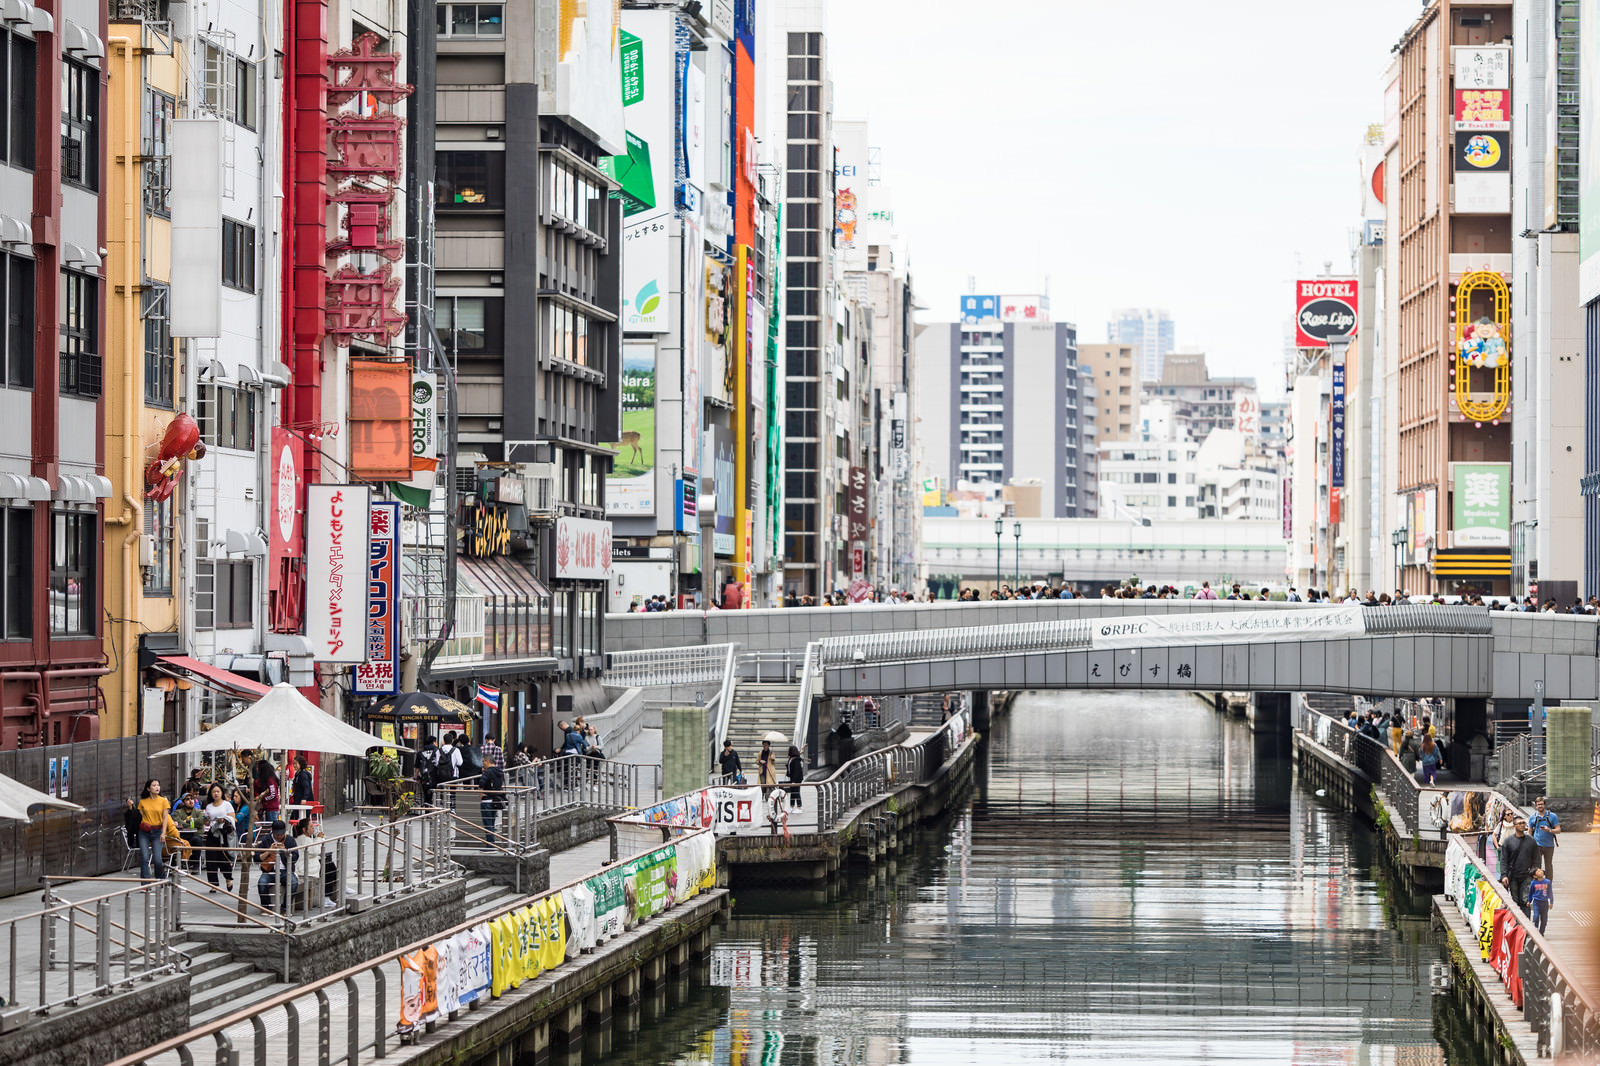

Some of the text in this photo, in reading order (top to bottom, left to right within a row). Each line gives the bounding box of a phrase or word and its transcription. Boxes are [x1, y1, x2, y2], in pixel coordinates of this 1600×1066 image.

[1301, 283, 1355, 297] HOTEL
[1301, 311, 1354, 330] Rose Lips
[1464, 472, 1500, 508] 薬
[328, 491, 344, 656] よしもとエンタメショップ
[357, 663, 393, 679] 免税
[1091, 663, 1192, 679] えびす橋
